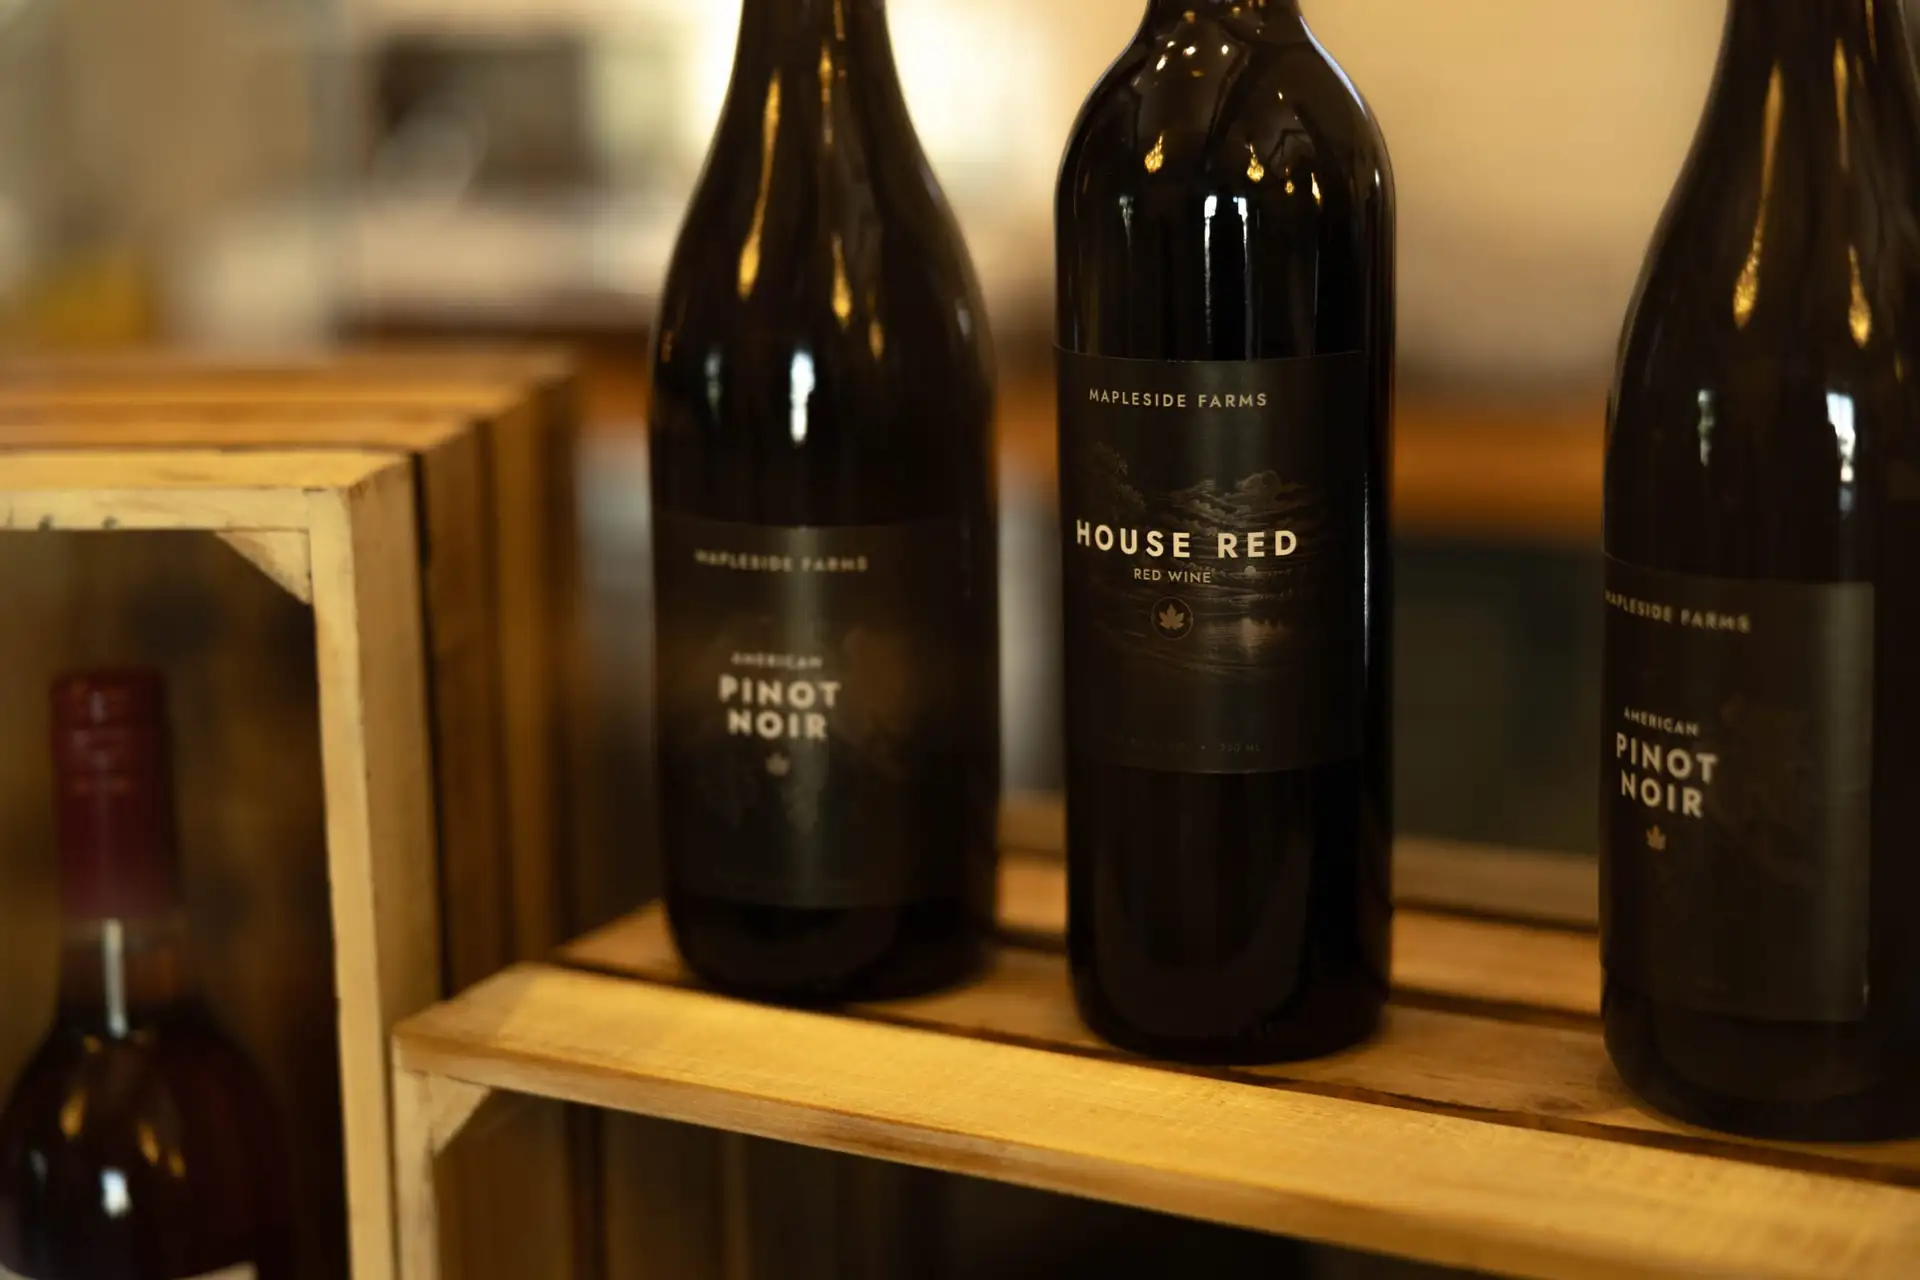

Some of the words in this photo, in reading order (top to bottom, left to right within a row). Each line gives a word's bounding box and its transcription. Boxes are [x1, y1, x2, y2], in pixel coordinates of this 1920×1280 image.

[1088, 388, 1187, 408] MAPLESIDE
[1198, 393, 1268, 408] FARMS
[1076, 518, 1191, 559] HOUSE
[1217, 530, 1299, 559] RED
[801, 555, 869, 573] FARMS
[1133, 567, 1162, 582] RED
[1168, 569, 1211, 584] WINE
[1680, 608, 1751, 633] FARMS
[718, 674, 842, 708] PINOT
[726, 708, 828, 741] NOIR
[1622, 706, 1700, 737] AMERICAN
[1615, 731, 1719, 785] PINOT
[1620, 769, 1705, 819] NOIR
